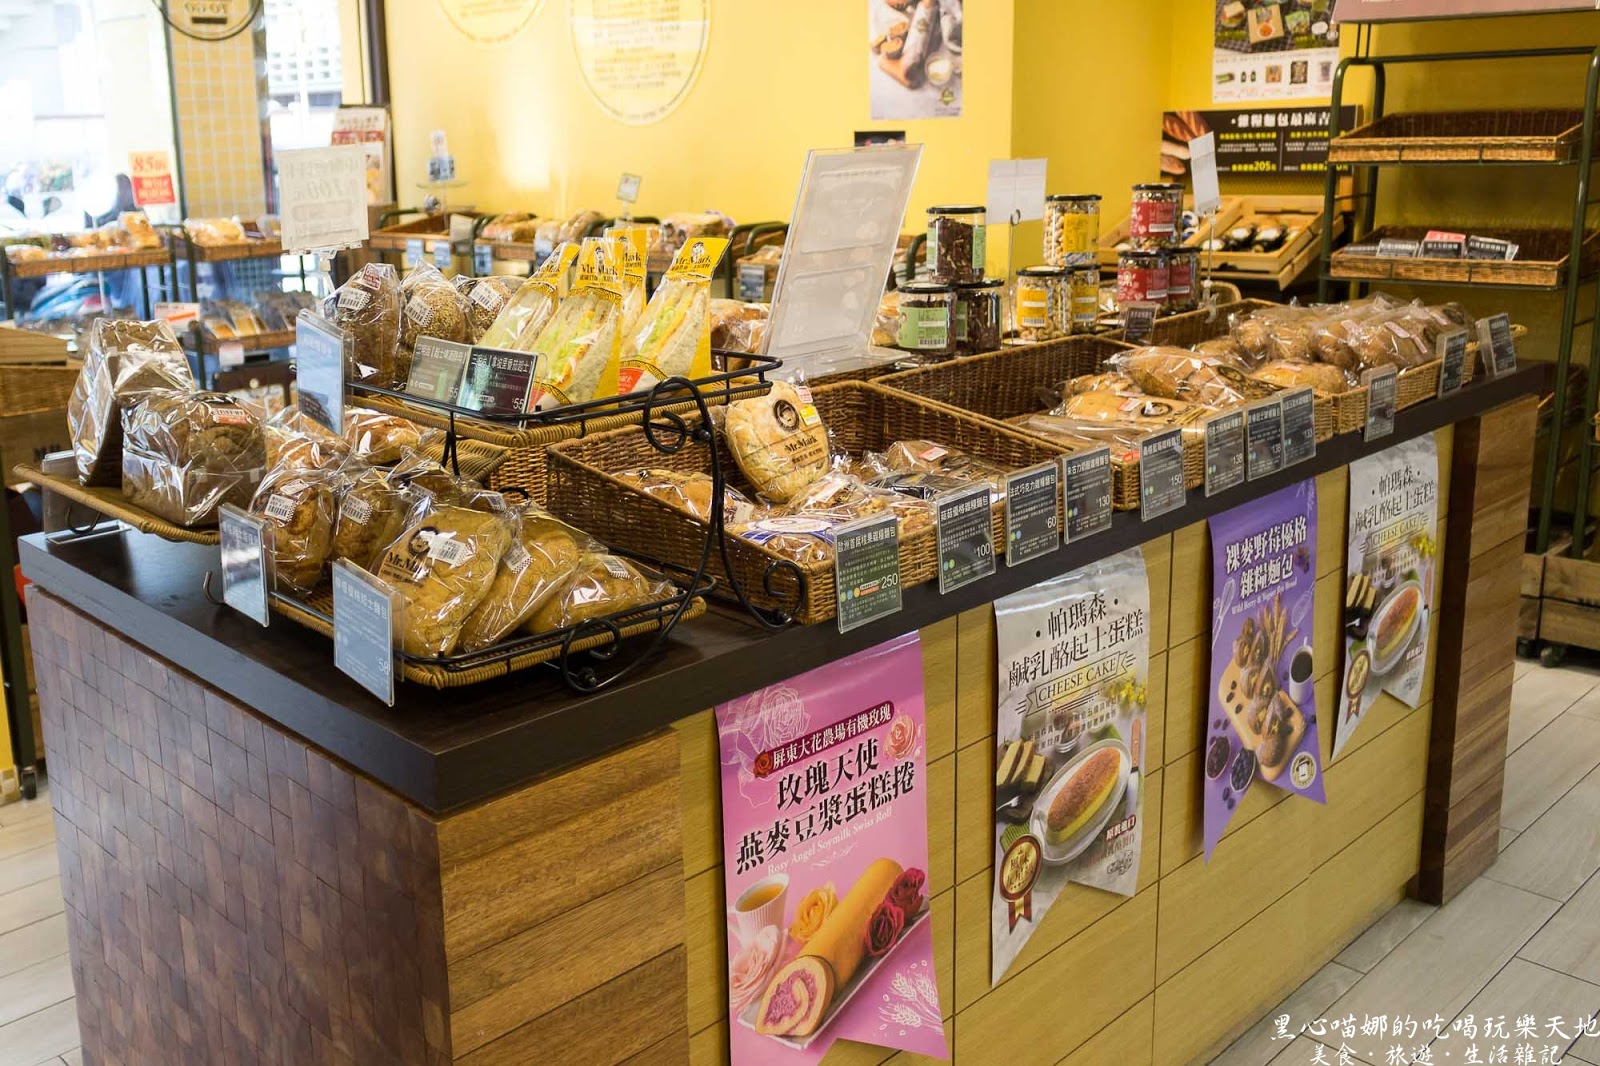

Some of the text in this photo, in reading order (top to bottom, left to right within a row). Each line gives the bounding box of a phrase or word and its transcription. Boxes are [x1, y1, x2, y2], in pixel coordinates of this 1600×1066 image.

[784, 435, 818, 453] Mr.Mark
[1371, 518, 1418, 547] CHEESE CAKE
[1239, 554, 1294, 599] 雜糧麵包
[1047, 593, 1108, 641] 帕瑪森
[1008, 609, 1144, 692] 鹹乳酪起士蛋糕
[1038, 656, 1117, 702] CHEESE CAKE
[773, 702, 892, 769] 屏東大花農場有機玫瑰
[777, 737, 880, 811] 玫瑰天使
[736, 761, 915, 875] 燕麥豆漿蛋糕捲
[767, 807, 893, 876] Rosy Angel Soymilk Swiss Roll
